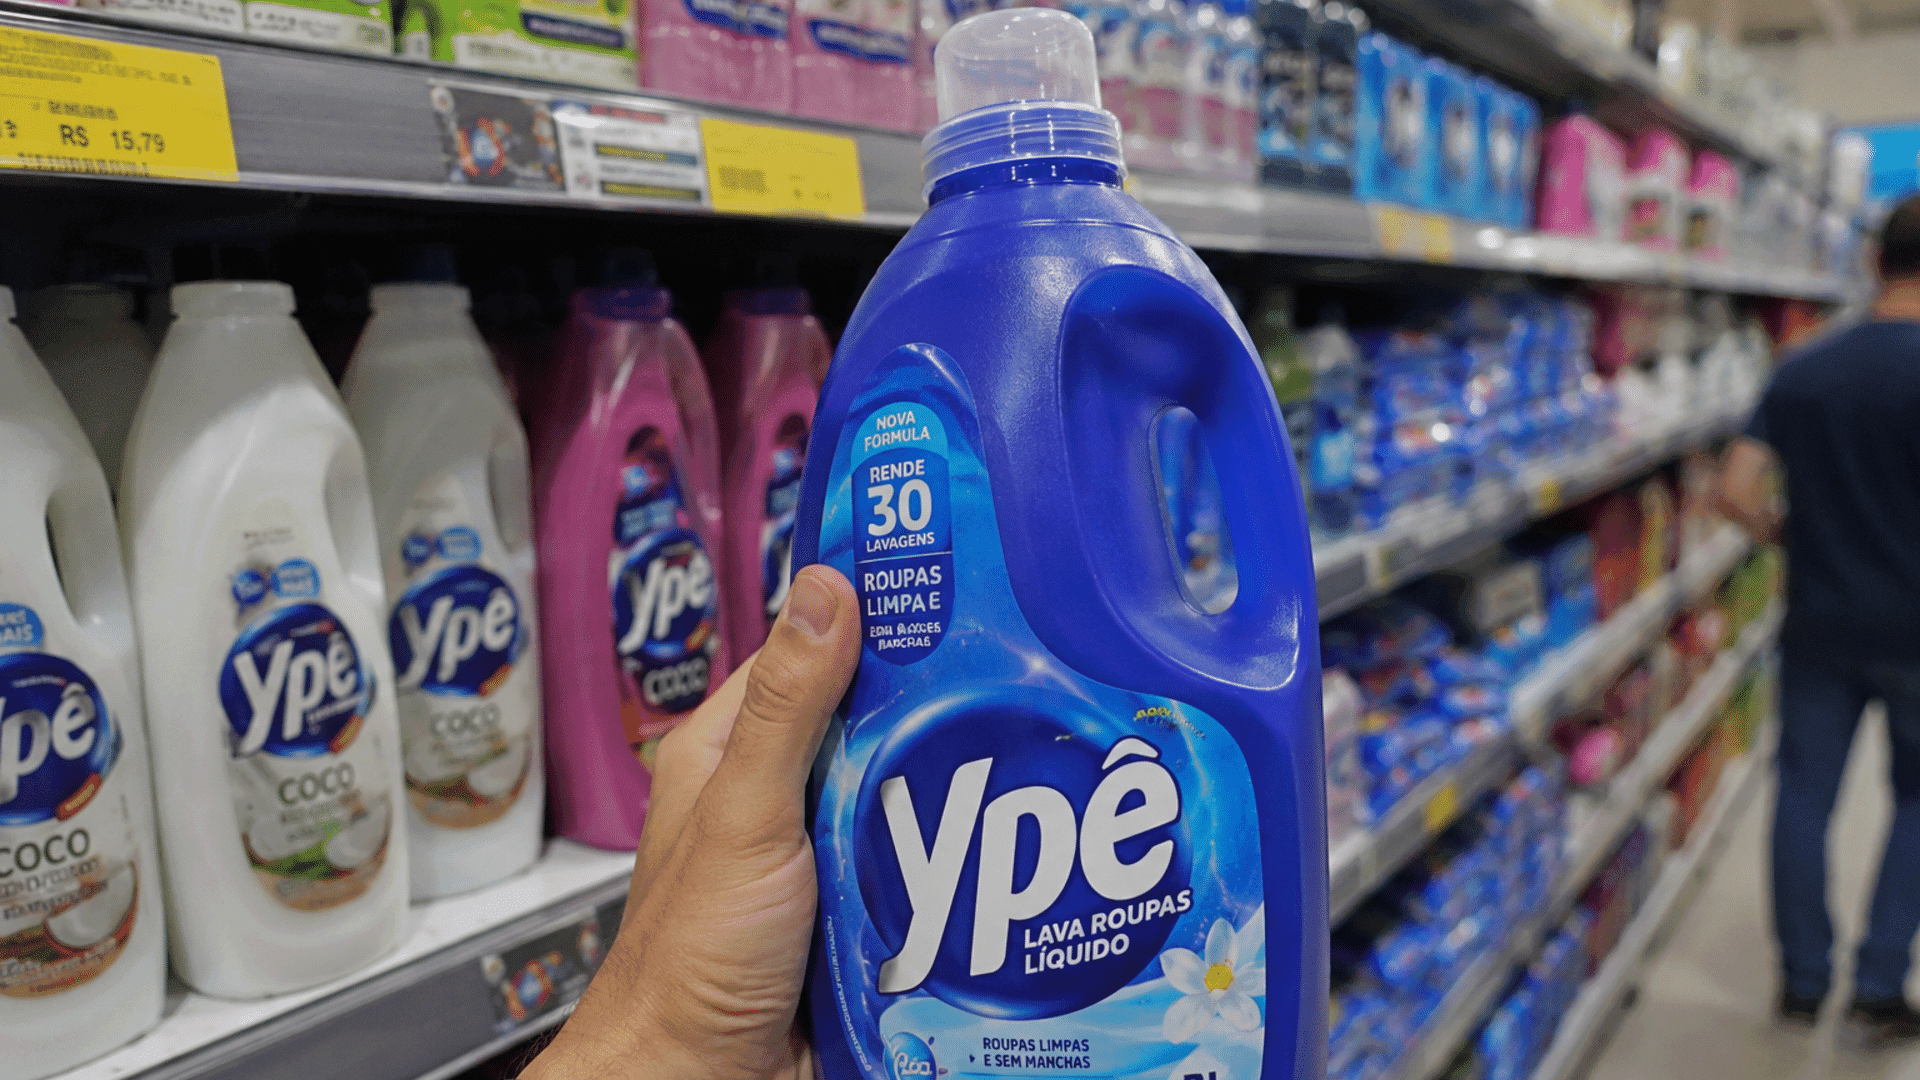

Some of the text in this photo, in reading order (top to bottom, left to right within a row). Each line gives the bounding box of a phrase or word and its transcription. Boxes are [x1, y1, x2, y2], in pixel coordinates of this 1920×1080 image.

[110, 130, 165, 155] 15,79
[876, 410, 916, 430] NOVA
[864, 425, 931, 452] FORMULA
[869, 459, 925, 483] RENDE
[867, 478, 932, 537] 30
[866, 532, 935, 553] LAVAGENS
[864, 565, 942, 592] ROUPAS
[867, 591, 941, 616] LIMPA E
[232, 631, 357, 752] Ypê
[277, 762, 355, 806] COCO
[878, 737, 1180, 994] Ypê
[1024, 889, 1191, 949] LAVA ROUPAS
[1024, 933, 1130, 974] LÍQUIDO
[983, 1037, 1090, 1053] ROUPAS LIMPAS
[984, 1054, 1091, 1069] E SEM MANCHAS
